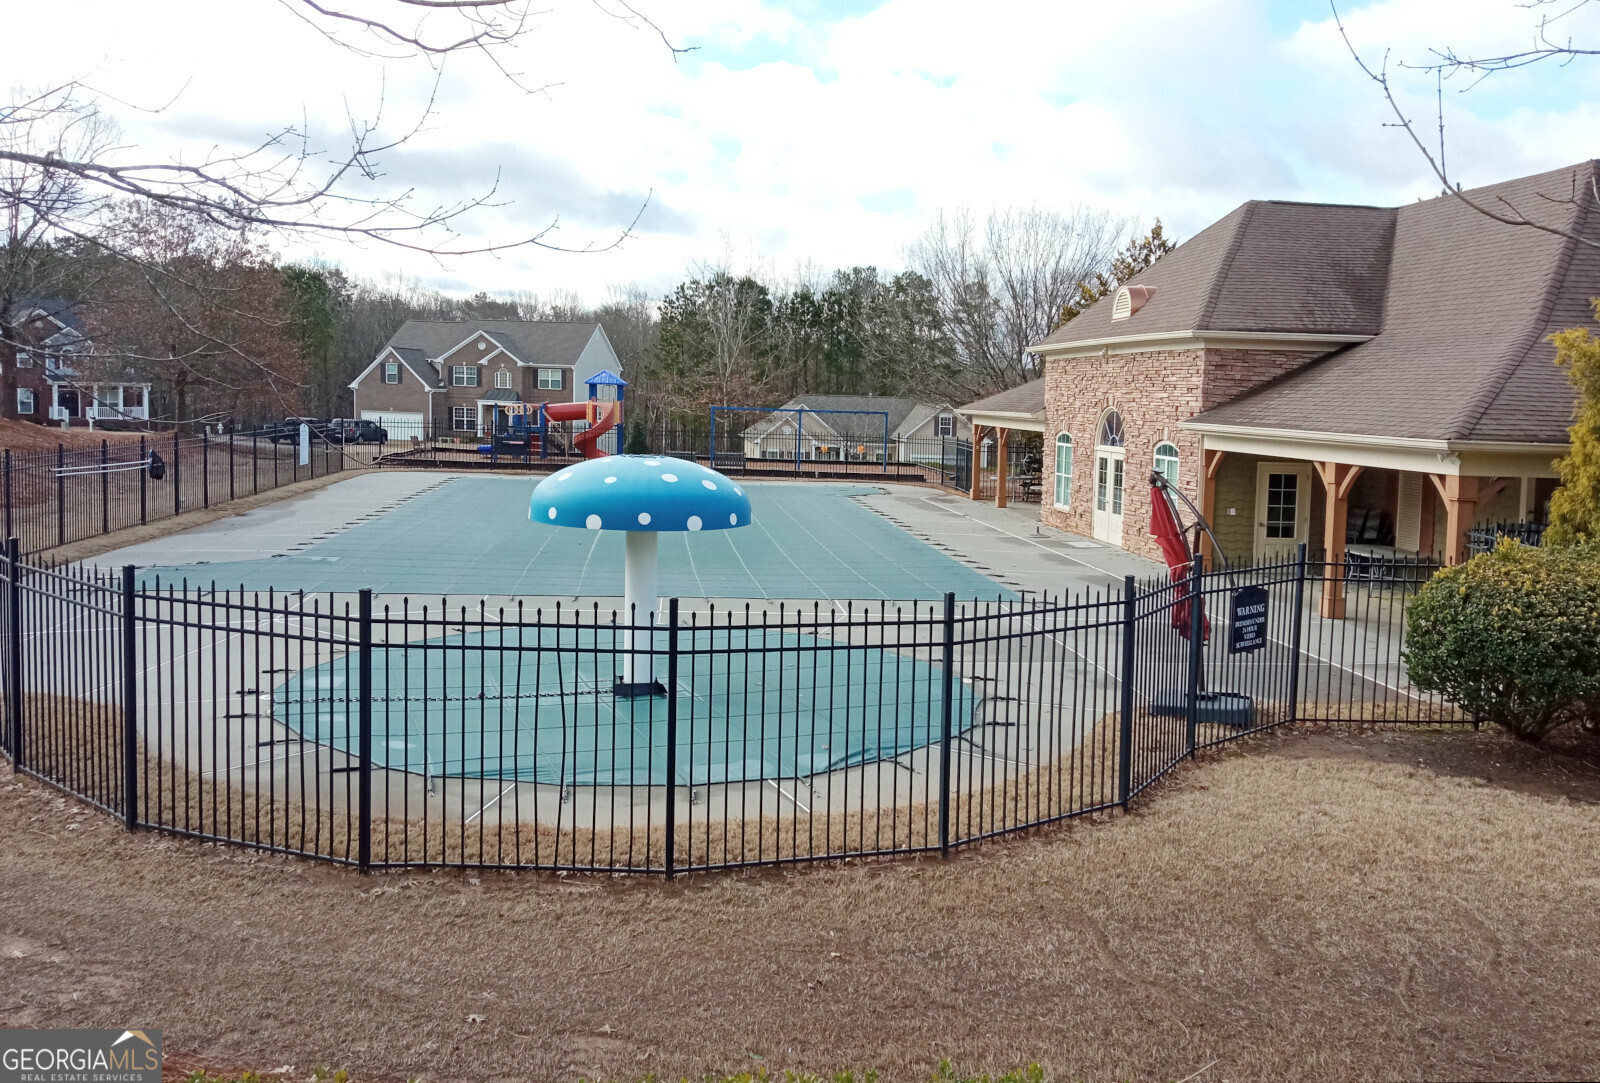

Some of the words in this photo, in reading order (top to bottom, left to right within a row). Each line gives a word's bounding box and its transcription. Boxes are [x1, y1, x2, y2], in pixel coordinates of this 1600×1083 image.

[1237, 604, 1265, 616] WARNING
[1235, 619, 1252, 628] PREMISES
[1235, 638, 1262, 648] SURVEILLANCE
